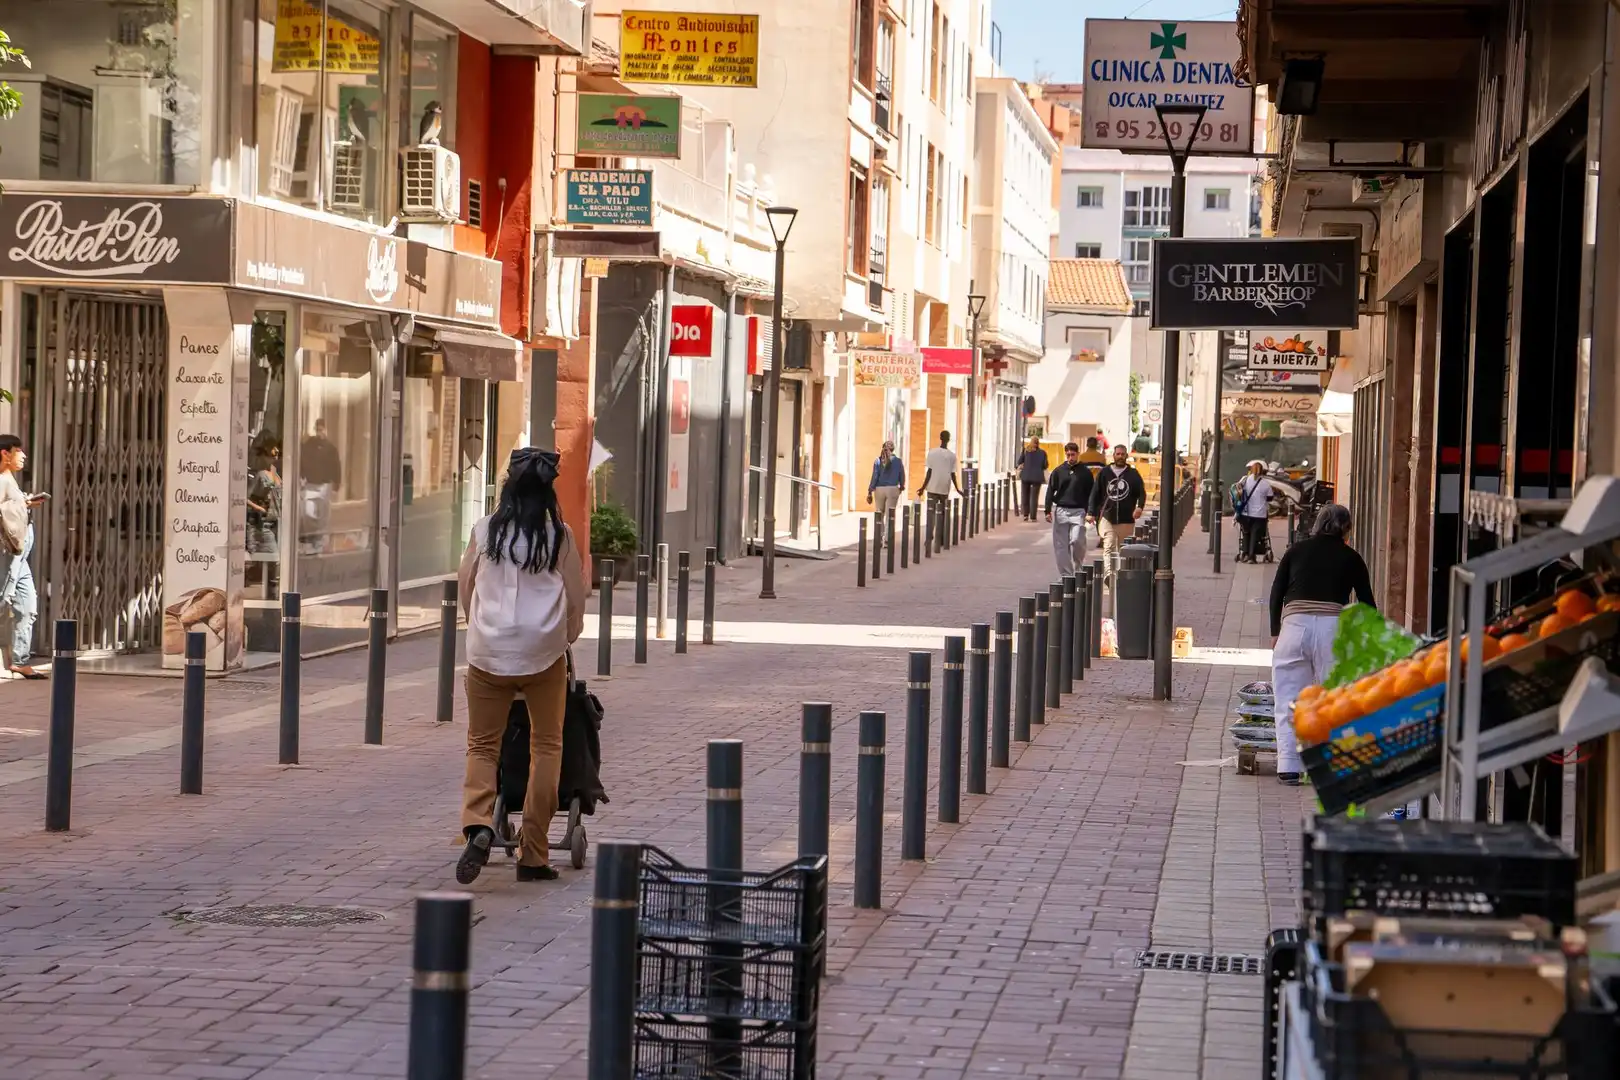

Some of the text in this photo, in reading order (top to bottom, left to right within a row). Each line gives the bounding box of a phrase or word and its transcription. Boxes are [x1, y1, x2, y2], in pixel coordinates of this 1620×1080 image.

[625, 15, 755, 34] Centro Audiovisual
[642, 32, 738, 54] Montes
[672, 62, 695, 71] OFICINA
[1091, 59, 1244, 85] CLINICA DENTA
[1108, 91, 1157, 109] OSCAR
[1116, 119, 1140, 140] 95
[1219, 123, 1239, 143] 81
[569, 171, 647, 184] ACADEMIA
[578, 184, 641, 197] EL PALO
[606, 196, 630, 205] VILU
[8, 199, 181, 277] Pastel-Pan
[1168, 263, 1345, 288] GENTLEMEN
[180, 335, 220, 355] Panes
[862, 355, 916, 365] FRUTERIA
[1253, 354, 1269, 365] LA
[1273, 354, 1319, 366] HUERTA
[175, 366, 225, 385] Laxante
[860, 365, 917, 376] VERDURAS
[179, 399, 219, 419] Espelta
[177, 428, 224, 444] Centeno
[177, 459, 221, 482] Integral
[174, 488, 220, 504] Alemán
[172, 518, 221, 539] Chapata
[175, 548, 216, 572] Gallego
